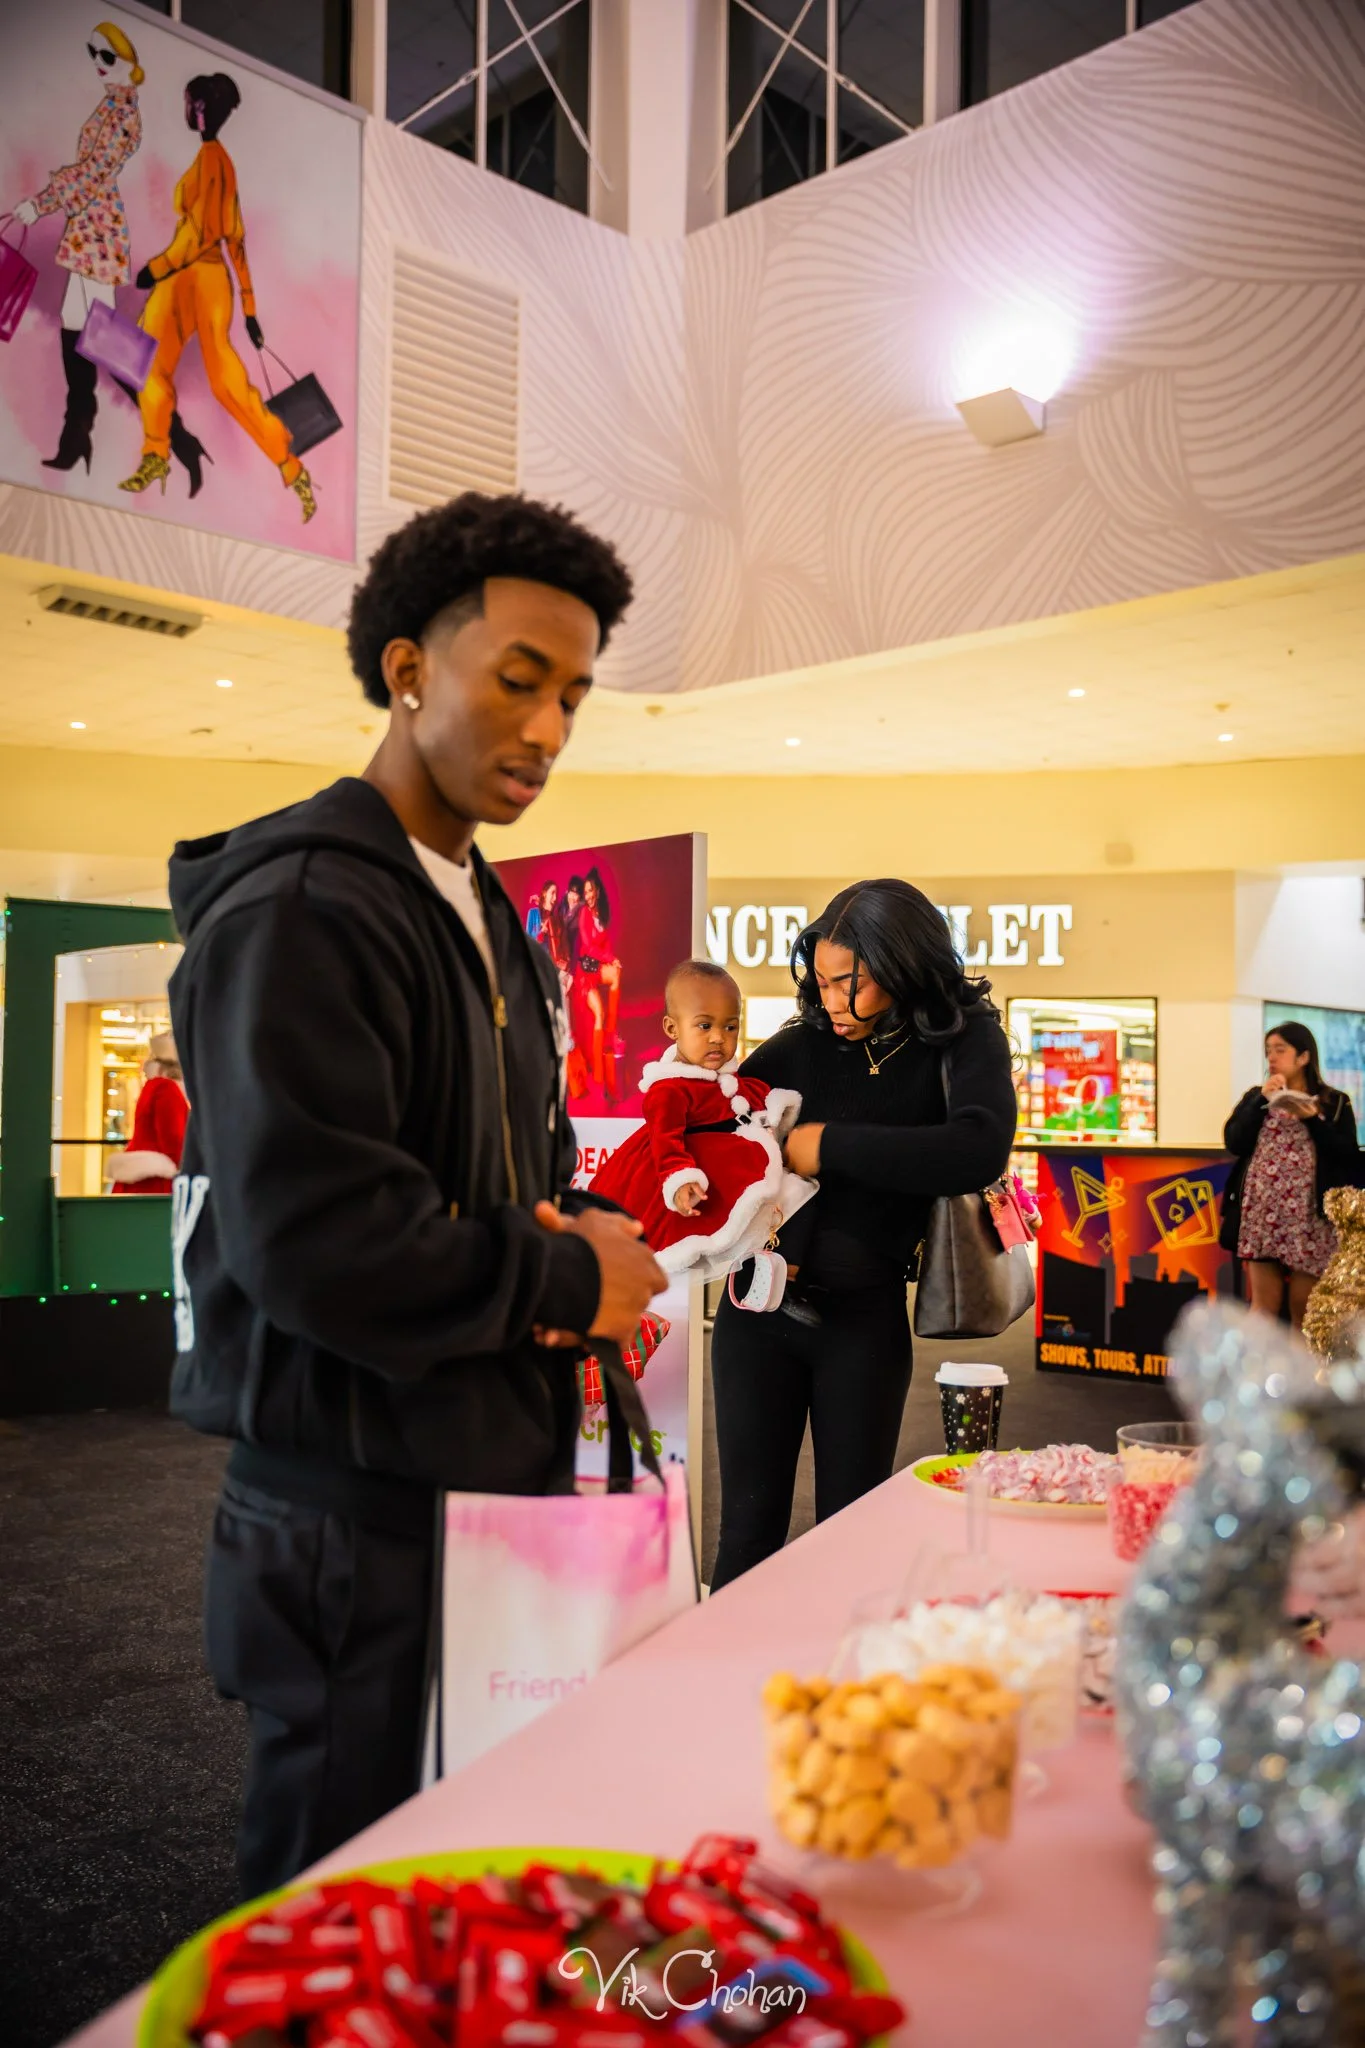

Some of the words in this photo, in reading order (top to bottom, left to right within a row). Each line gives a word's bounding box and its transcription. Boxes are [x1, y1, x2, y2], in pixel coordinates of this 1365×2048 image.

[936, 904, 1073, 967] LET
[1040, 1342, 1091, 1370] SHOWS,
[1093, 1348, 1141, 1376] TOURS,
